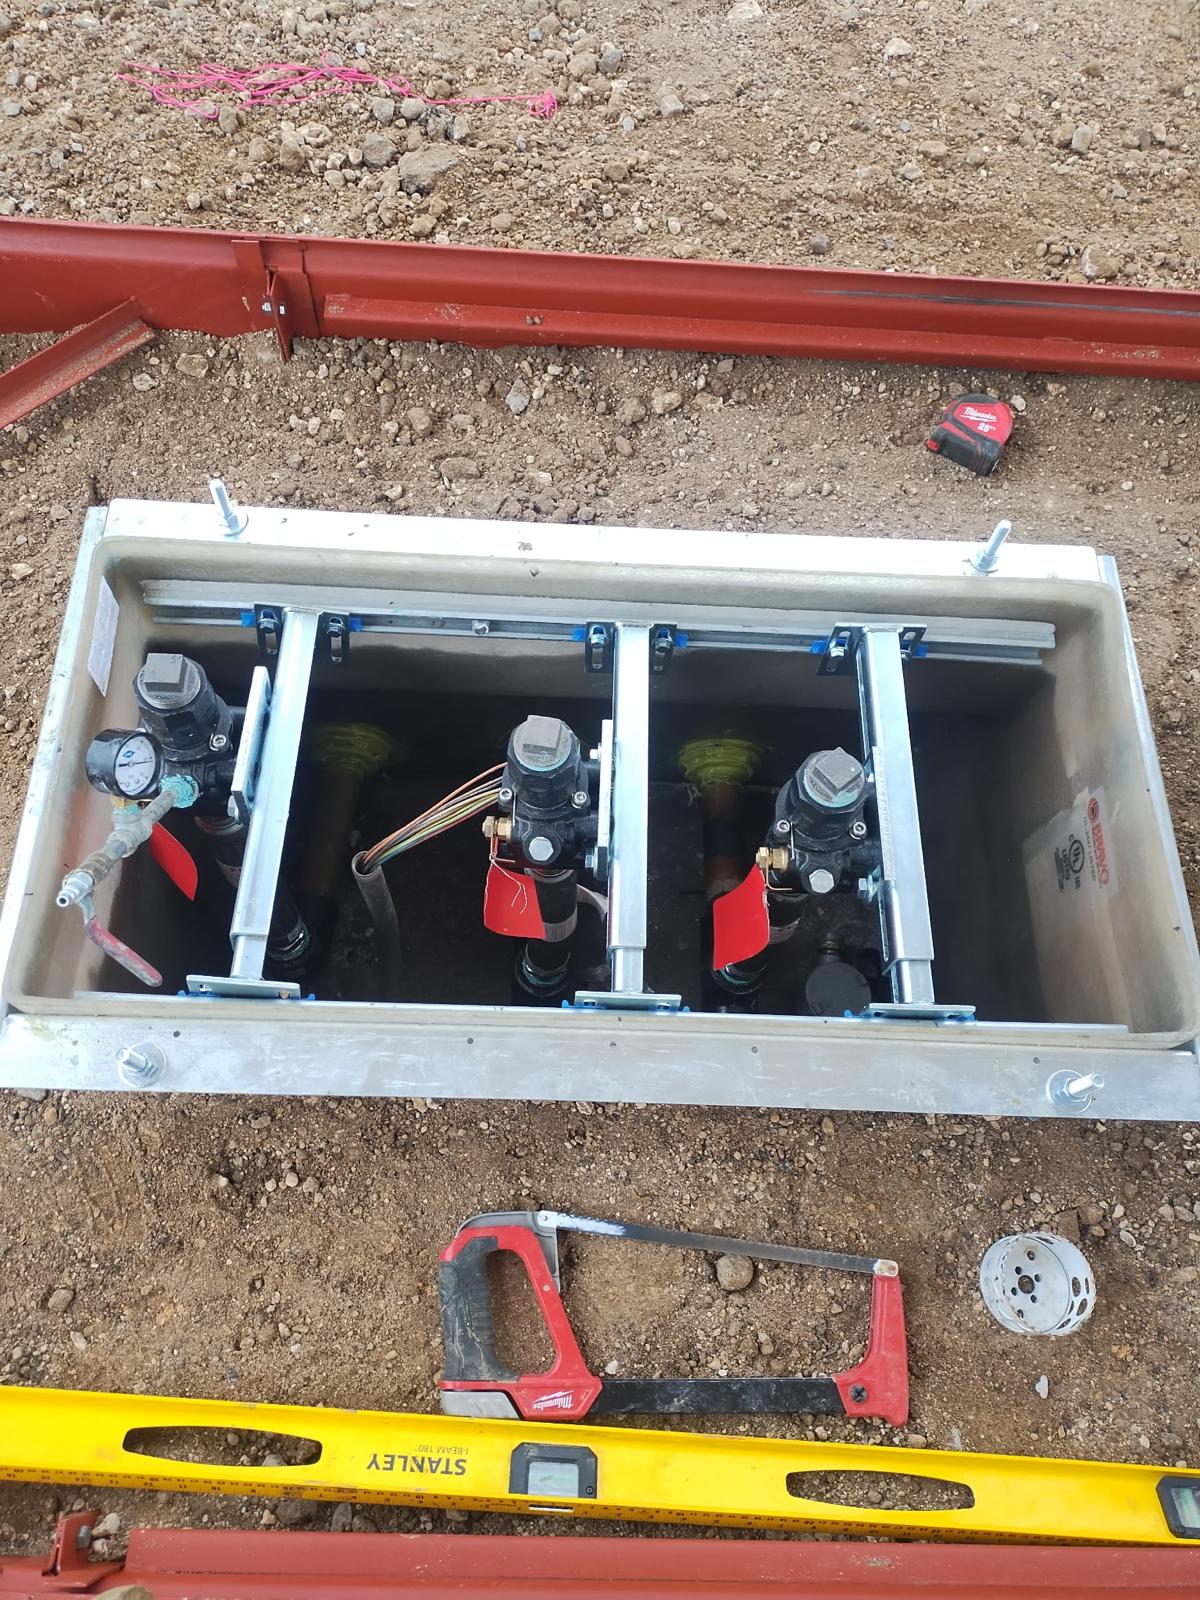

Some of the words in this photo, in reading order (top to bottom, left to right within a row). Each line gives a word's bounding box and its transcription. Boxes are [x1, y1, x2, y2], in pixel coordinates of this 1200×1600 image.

[963, 406, 997, 421] Milwaukee
[1092, 824, 1109, 886] BRAVO
[532, 1394, 574, 1411] Milwaukee
[366, 1453, 467, 1475] STANLEY
